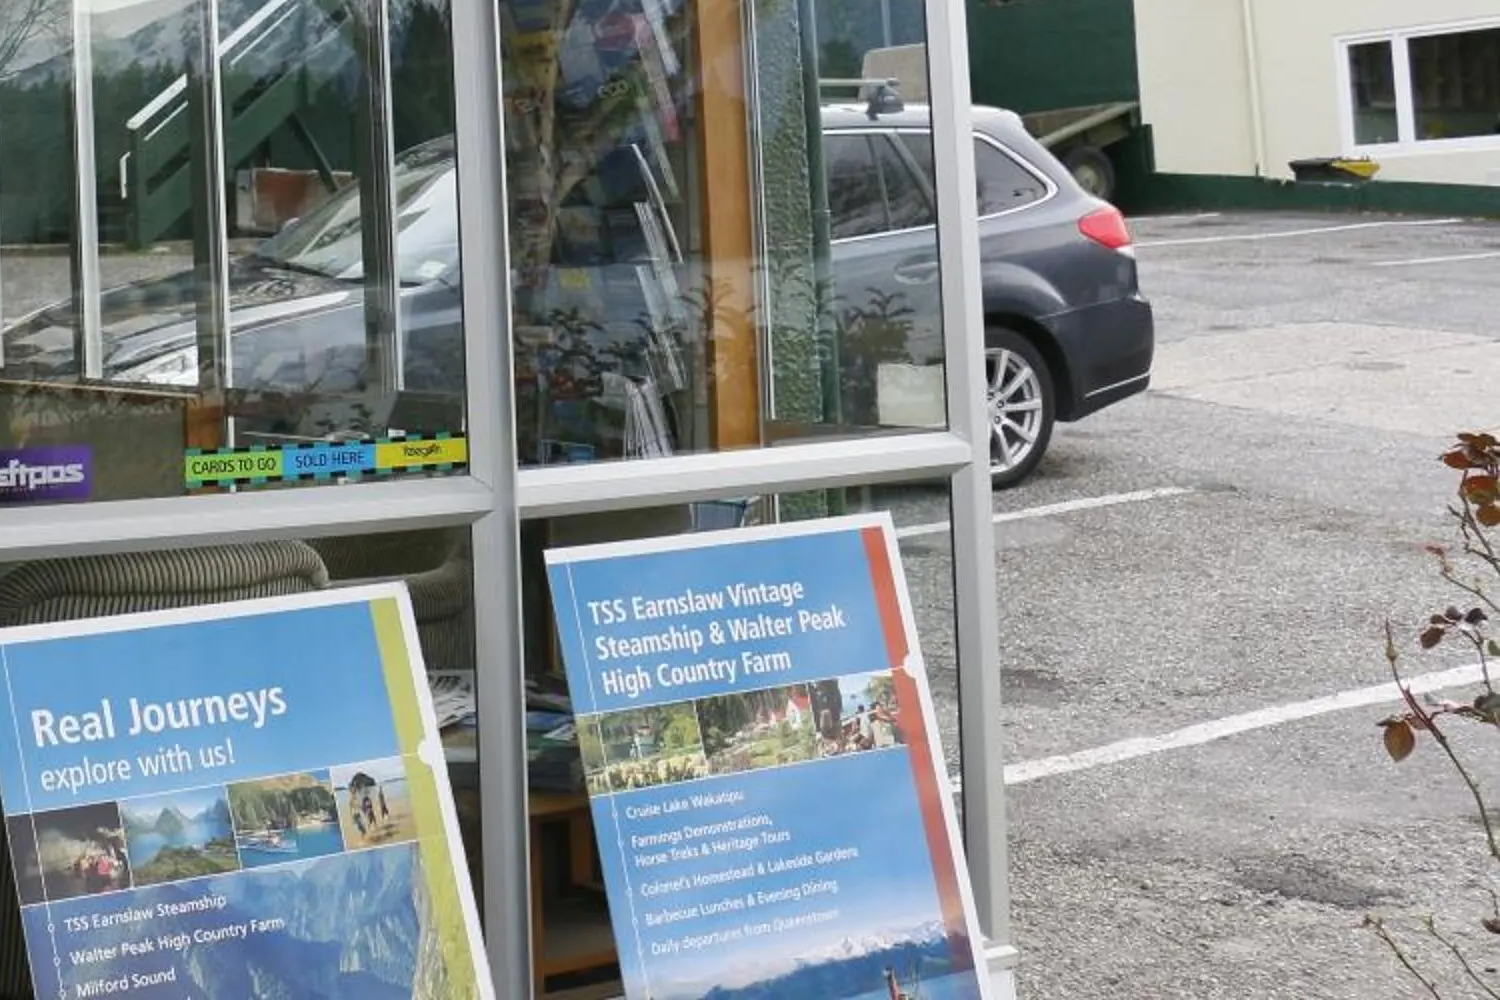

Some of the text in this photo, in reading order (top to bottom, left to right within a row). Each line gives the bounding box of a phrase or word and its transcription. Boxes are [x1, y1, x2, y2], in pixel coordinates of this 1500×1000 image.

[191, 457, 277, 475] CARDS TO GO
[295, 450, 366, 469] SOLD HERE
[588, 581, 805, 625] TSS Earnslaw Vintage
[595, 603, 848, 661] Steamship & Walter Peak
[602, 650, 792, 699] High Country Farm
[31, 685, 288, 748] Real Journeys
[40, 736, 236, 795] explore with us!
[626, 803, 662, 819] Cruise
[663, 798, 689, 814] Lake
[635, 829, 791, 868] Horse Treks & Heritage Tours
[693, 866, 755, 887] Homestead
[757, 862, 766, 876] &
[767, 855, 814, 874] Lakeside
[815, 846, 859, 865] Gardens
[64, 893, 227, 933] TSS Earnslaw Steamship
[644, 905, 699, 927] Barbecue
[700, 896, 745, 917] Lunches
[757, 884, 801, 906] Evening
[802, 878, 840, 898] Dining
[69, 917, 285, 966] Walter Peak High Country Farm
[651, 938, 681, 956] Daily
[682, 927, 743, 950] departures
[744, 920, 771, 937] from
[75, 967, 177, 999] Milford Sound
